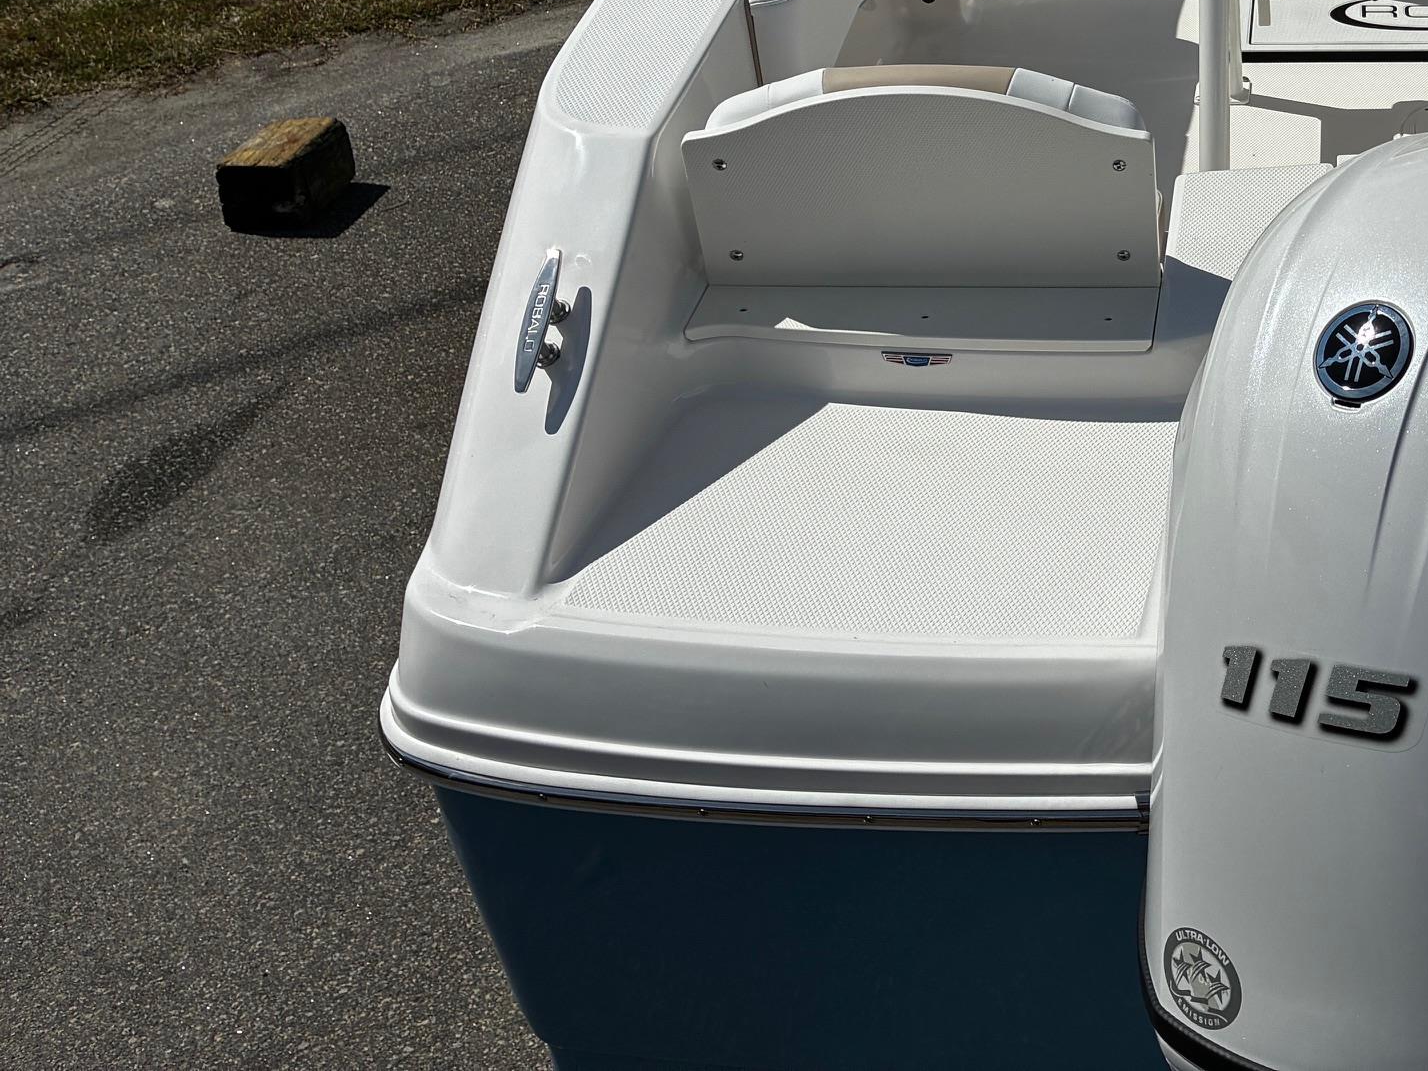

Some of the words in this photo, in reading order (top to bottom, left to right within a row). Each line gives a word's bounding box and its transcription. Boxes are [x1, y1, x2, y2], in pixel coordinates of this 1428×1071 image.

[524, 284, 550, 352] ROBALO
[1220, 645, 1419, 743] 115
[1177, 997, 1221, 1026] EMISSION
